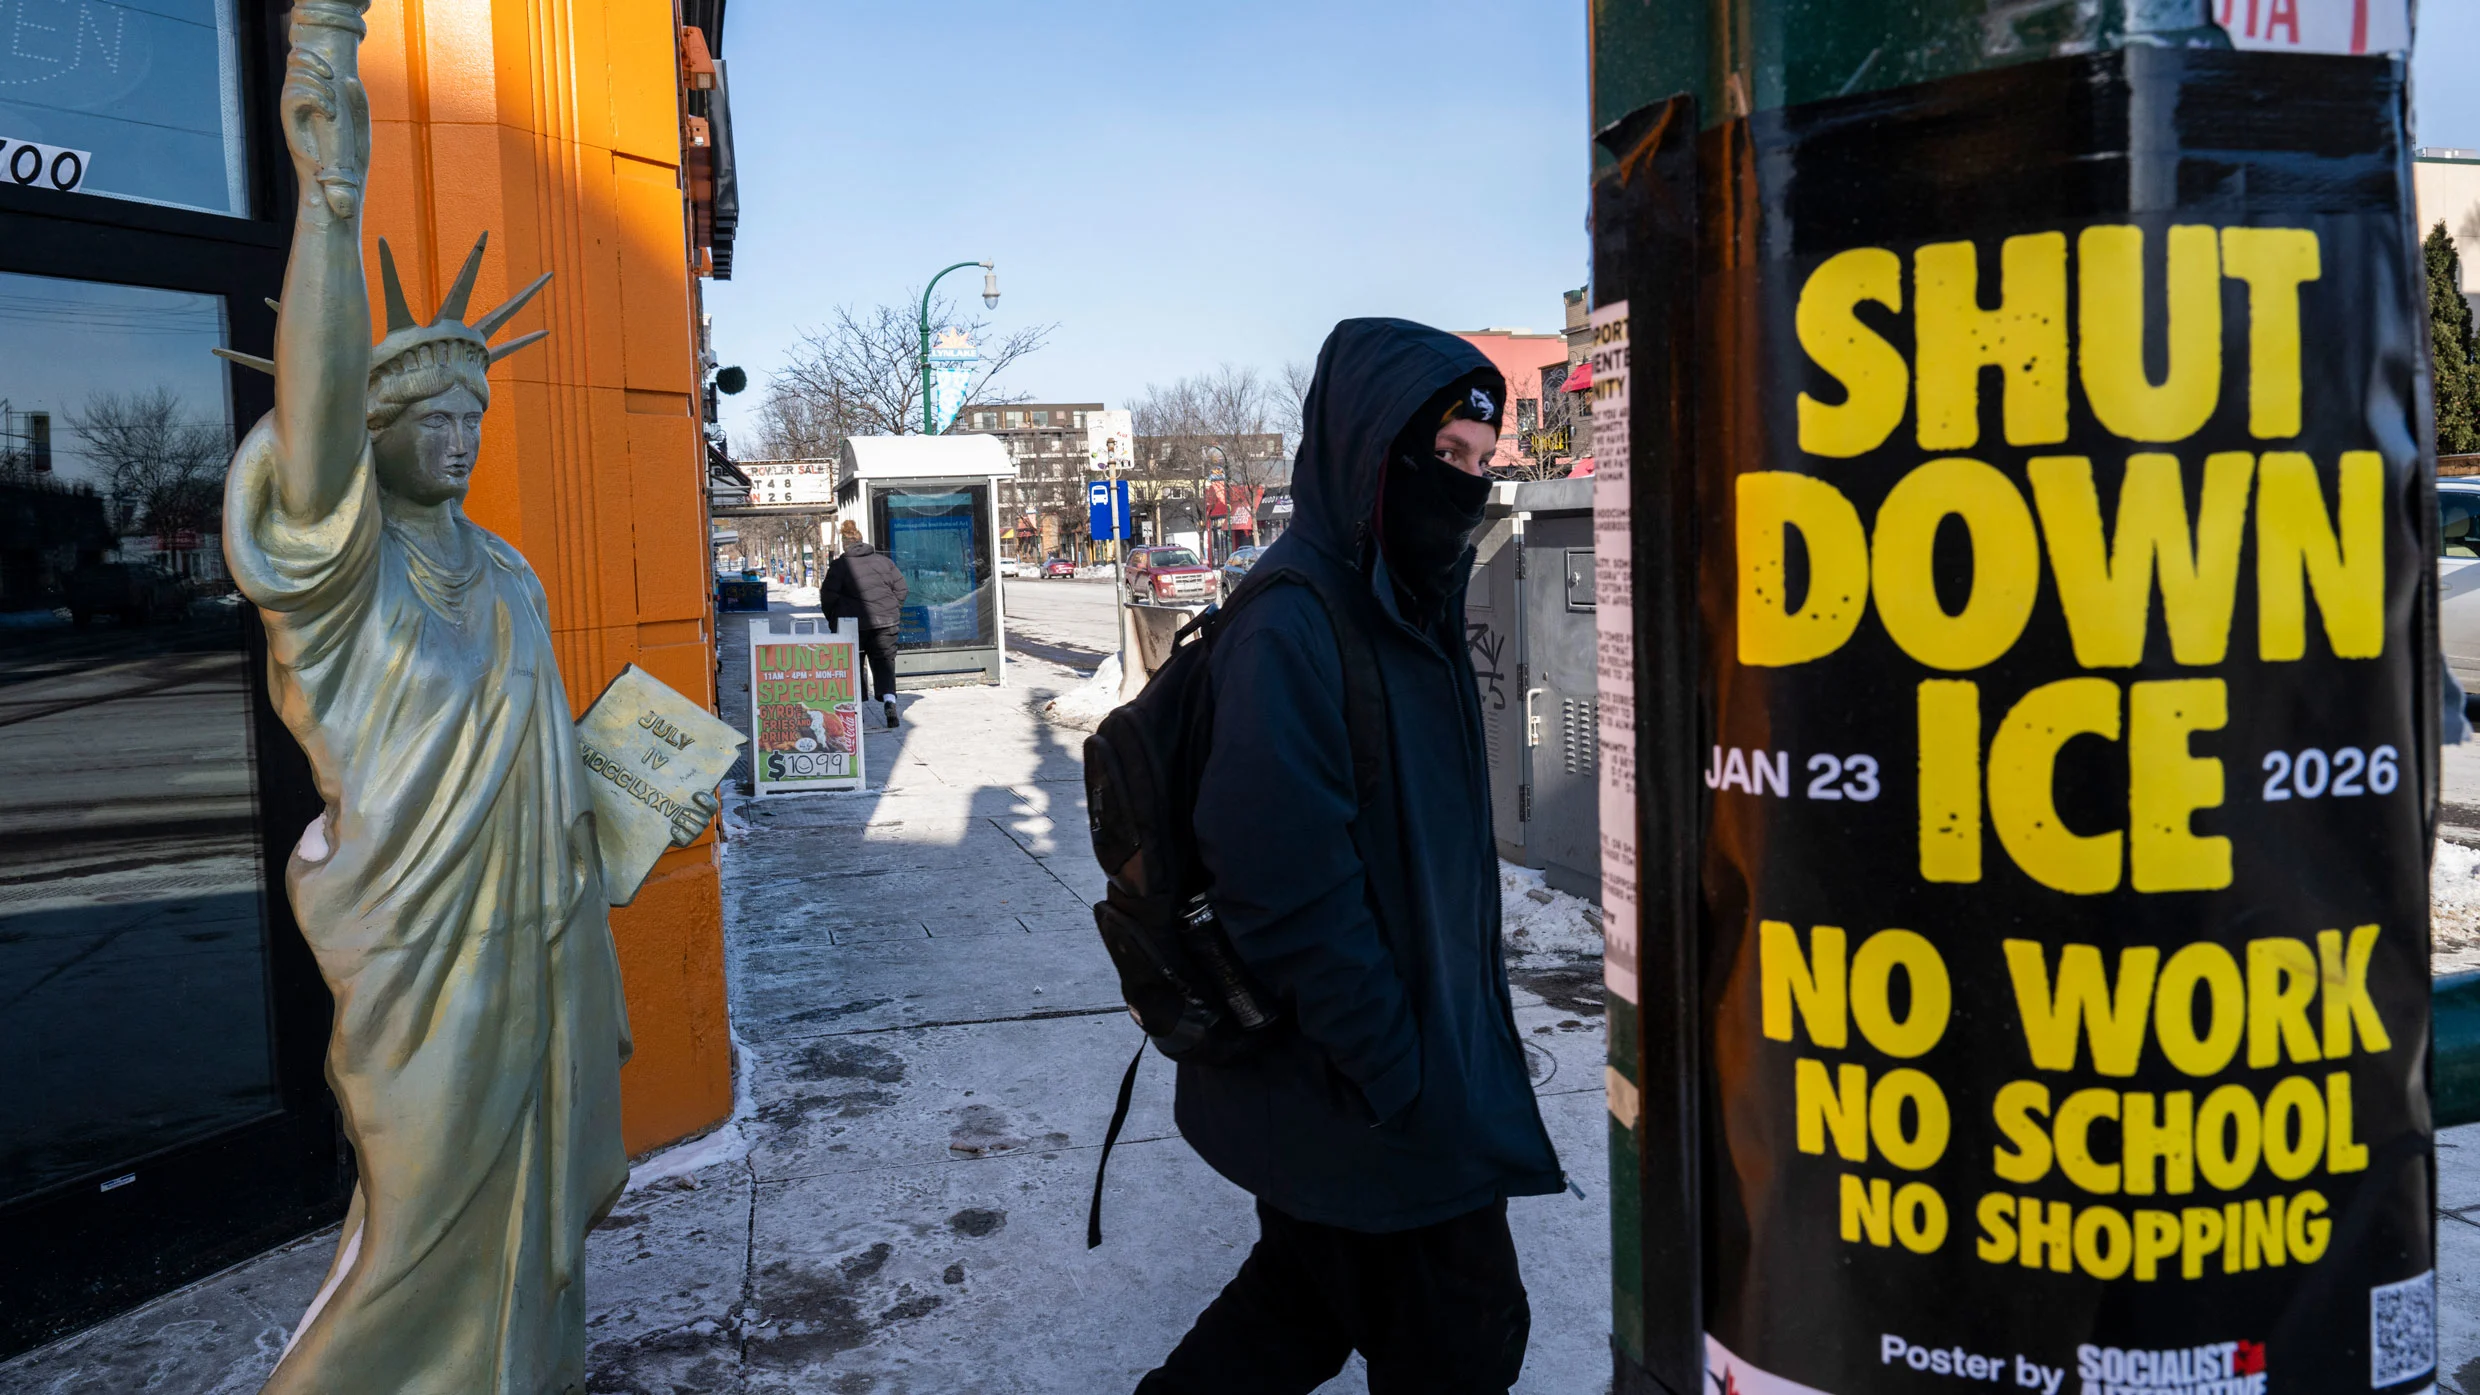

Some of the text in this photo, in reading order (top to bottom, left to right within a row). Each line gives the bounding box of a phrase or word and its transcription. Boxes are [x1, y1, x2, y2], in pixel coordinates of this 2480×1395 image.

[0, 139, 82, 191] 00
[1796, 225, 2320, 458] SHUT
[1737, 451, 2384, 670] DOWN
[760, 645, 849, 671] LUNCH
[764, 672, 784, 681] 11AM
[791, 671, 808, 680] 4PM
[815, 670, 847, 679] MON-FRI
[758, 680, 854, 703] SPECIAL
[759, 704, 794, 719] GYRO
[638, 710, 695, 751] JULY
[760, 730, 797, 742] DRINK
[763, 719, 796, 731] FRIES
[641, 748, 670, 771] IV
[1705, 744, 2399, 801] JAN 23 2026
[1916, 678, 2232, 894] ICE
[1760, 920, 2391, 1077] NO WORK
[1796, 1058, 2367, 1194] NO SCHOOL
[1840, 1174, 2331, 1281] NO SHOPPING
[1881, 1333, 2006, 1382] Poster
[2016, 1354, 2065, 1395] by
[2077, 1341, 2238, 1388] SOCIALIST
